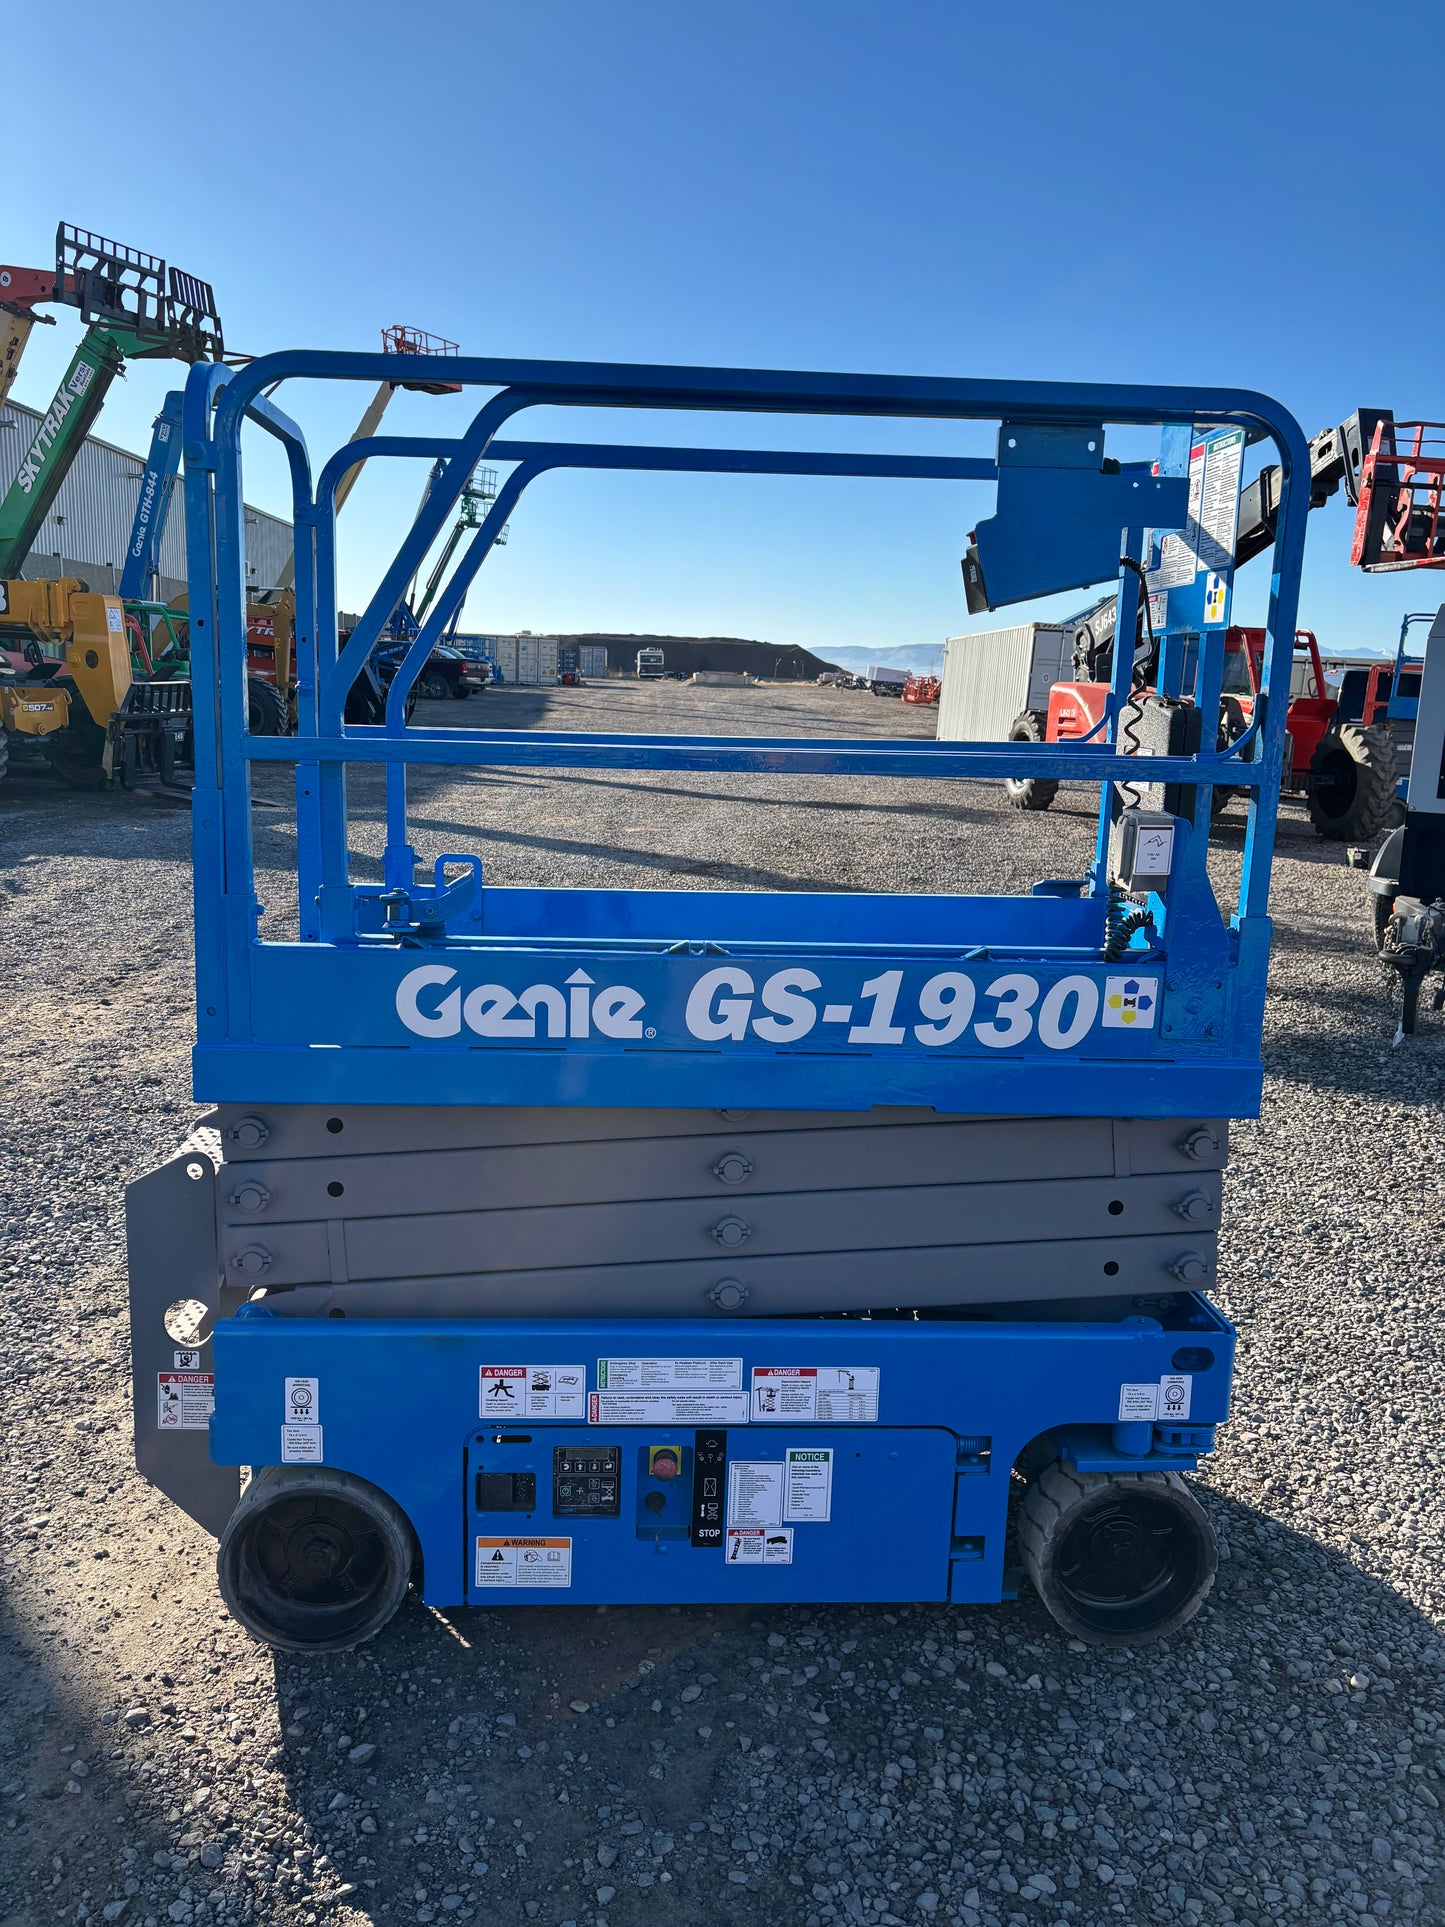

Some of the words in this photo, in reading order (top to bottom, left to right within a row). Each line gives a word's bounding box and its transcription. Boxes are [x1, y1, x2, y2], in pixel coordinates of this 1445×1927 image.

[18, 382, 76, 494] SKYTRAK
[139, 470, 159, 524] GTH-844
[132, 526, 147, 557] Genie
[1095, 605, 1117, 636] SJ643
[396, 964, 646, 1038] Genie
[685, 966, 1099, 1050] GS-1930
[494, 1369, 523, 1377] DANGER
[795, 1453, 825, 1461] NOTICE
[511, 1539, 546, 1547] WARNING
[698, 1529, 721, 1538] STOP
